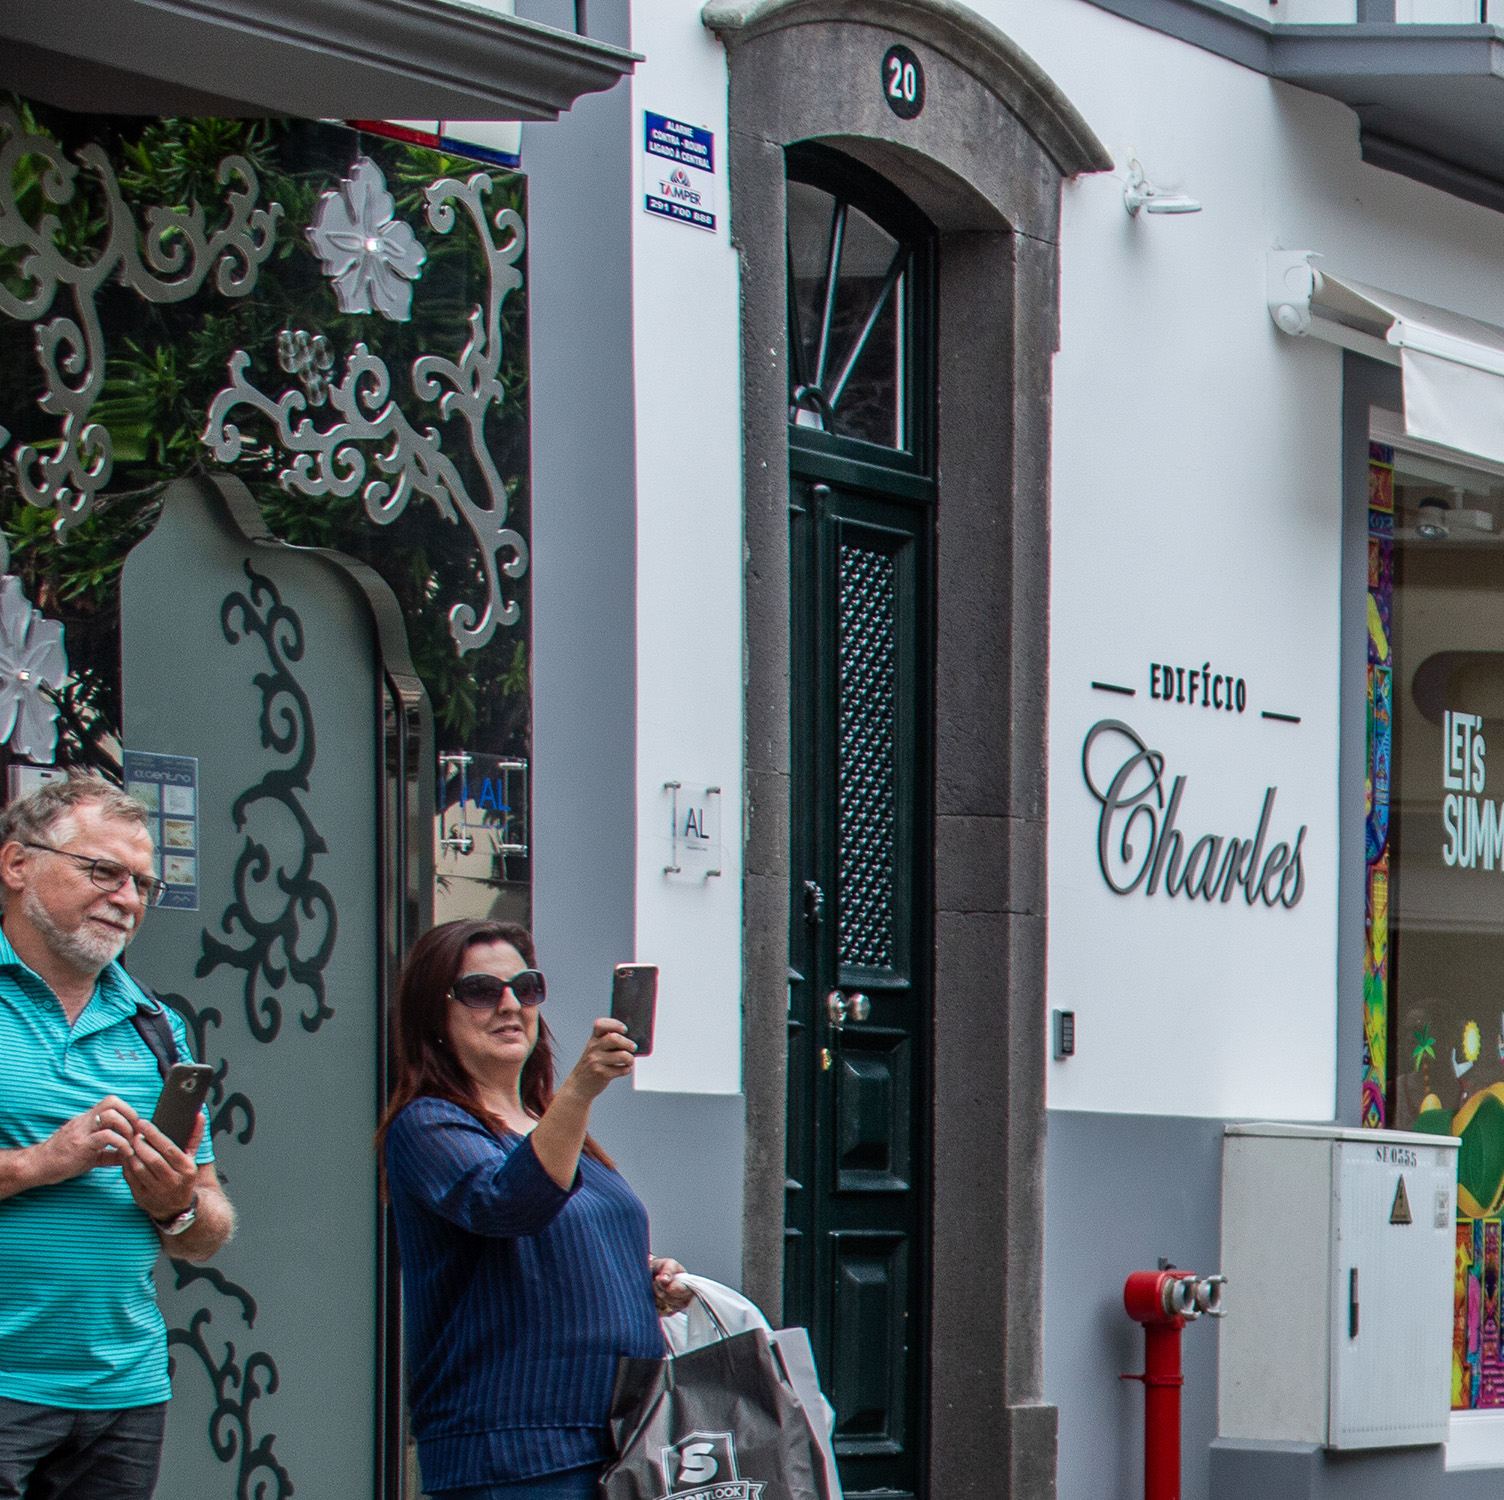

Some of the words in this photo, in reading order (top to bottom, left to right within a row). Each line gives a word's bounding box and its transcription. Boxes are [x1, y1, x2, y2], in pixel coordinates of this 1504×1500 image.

[888, 56, 917, 102] 20
[649, 198, 670, 212] 291
[671, 204, 692, 218] 700
[659, 181, 702, 206] TAMPER
[1150, 661, 1248, 714] EDIFÍCIO
[684, 806, 710, 840] AL
[1081, 718, 1308, 910] Charles
[679, 1442, 719, 1484] S
